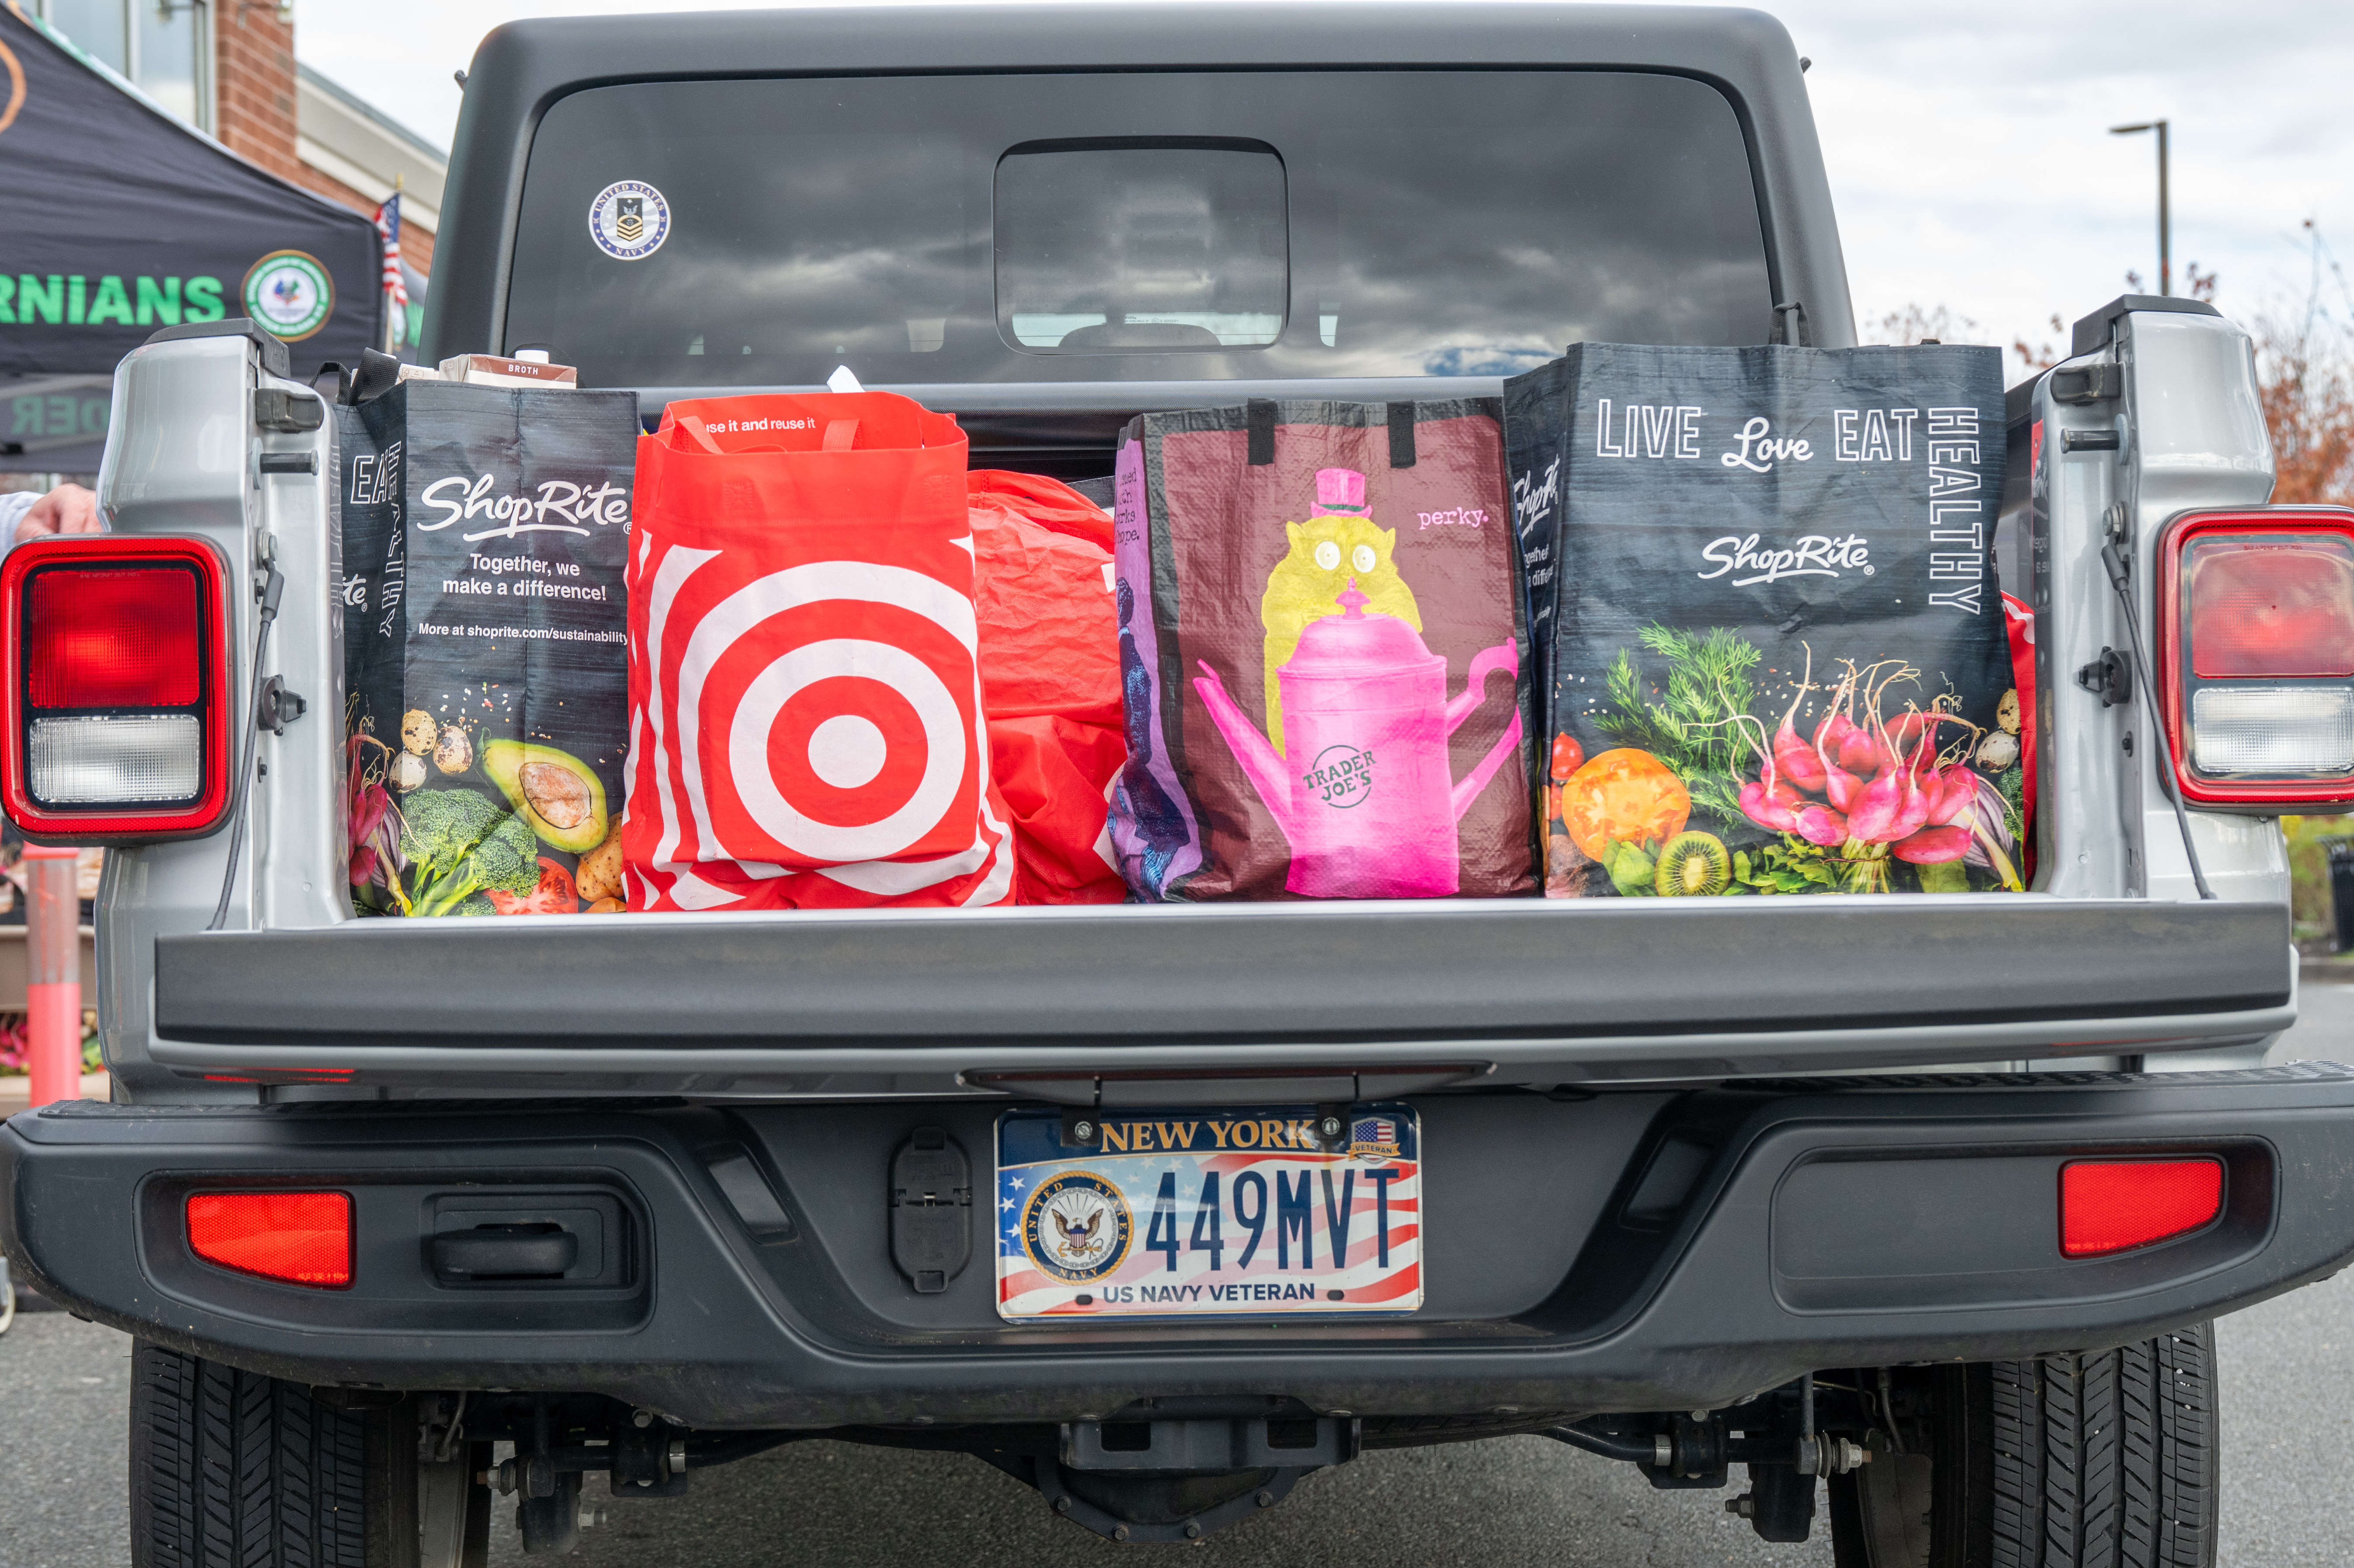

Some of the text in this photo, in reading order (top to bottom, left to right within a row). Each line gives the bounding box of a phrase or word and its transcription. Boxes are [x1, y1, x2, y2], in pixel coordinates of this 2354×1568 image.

[595, 183, 664, 213] UNITED STATES
[615, 246, 646, 257] NAVY
[508, 364, 538, 375] BROTH
[728, 420, 738, 432] it
[741, 417, 768, 431] and
[770, 420, 805, 430] reuse
[807, 416, 816, 428] it
[1597, 399, 1918, 473] LIVE Love EAT
[1417, 506, 1489, 530] perky.
[1928, 407, 1982, 615] HEALTHY
[469, 553, 580, 576] Together, we
[442, 578, 606, 601] make a difference!
[419, 623, 628, 645] More at shoprite.com/sustainability
[1303, 751, 1377, 790] TRADER
[1321, 770, 1371, 801] JOE'S
[1099, 1120, 1315, 1152] NEW YORK
[1355, 1145, 1392, 1154] VETERAN
[1029, 1182, 1127, 1242] UNITED STATES
[1146, 1169, 1399, 1272] 449MVT
[1059, 1268, 1098, 1279] NAVY
[1103, 1283, 1315, 1303] US NAVY VETERAN
